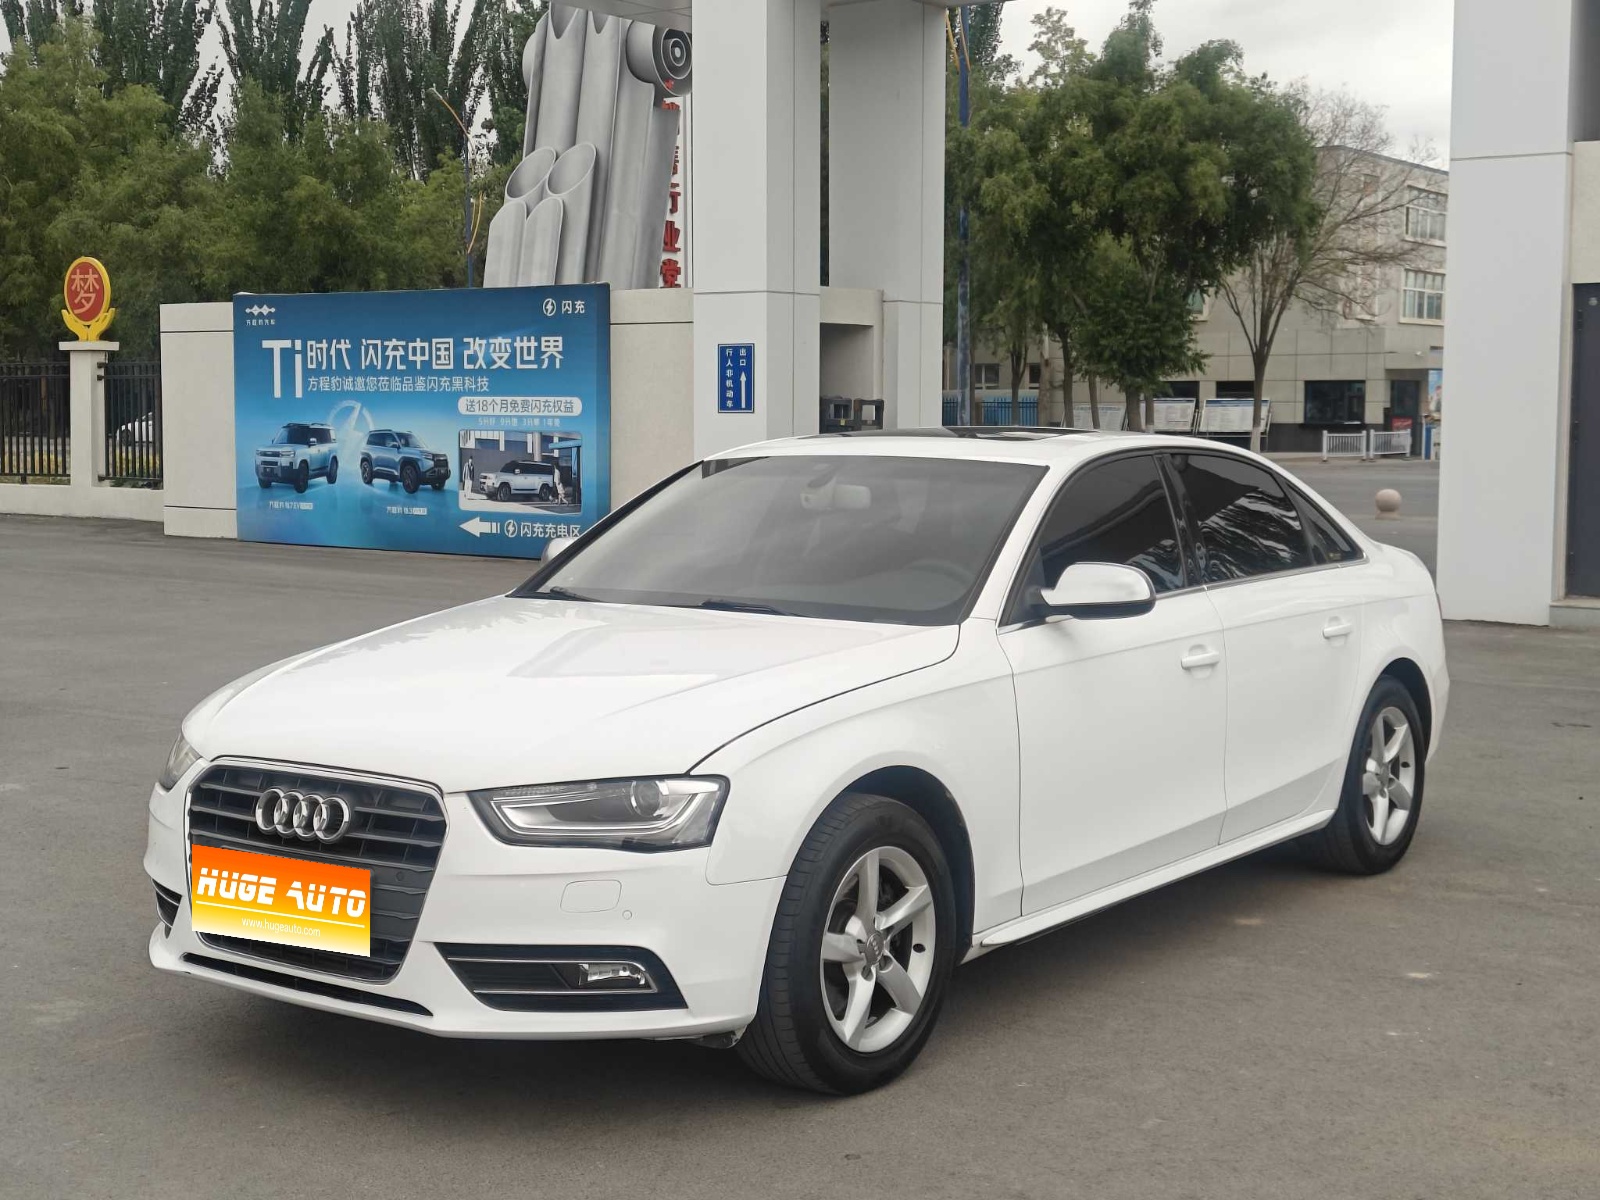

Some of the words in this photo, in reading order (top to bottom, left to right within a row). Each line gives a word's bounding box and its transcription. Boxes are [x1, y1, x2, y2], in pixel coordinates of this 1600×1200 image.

[71, 268, 100, 314] 梦
[561, 300, 585, 314] 闪充
[307, 339, 351, 370] 时代
[361, 337, 454, 370] 闪充中国
[463, 336, 564, 369] 改变世界
[739, 348, 747, 366] 出口
[262, 339, 303, 398] Ti
[307, 375, 490, 392] 方程豹诚邀您莅临品鉴闪充黑科技
[726, 348, 734, 408] 行人非机动车
[465, 399, 574, 413] 送18个月免费闪充权益
[520, 522, 581, 538] 闪充充电区
